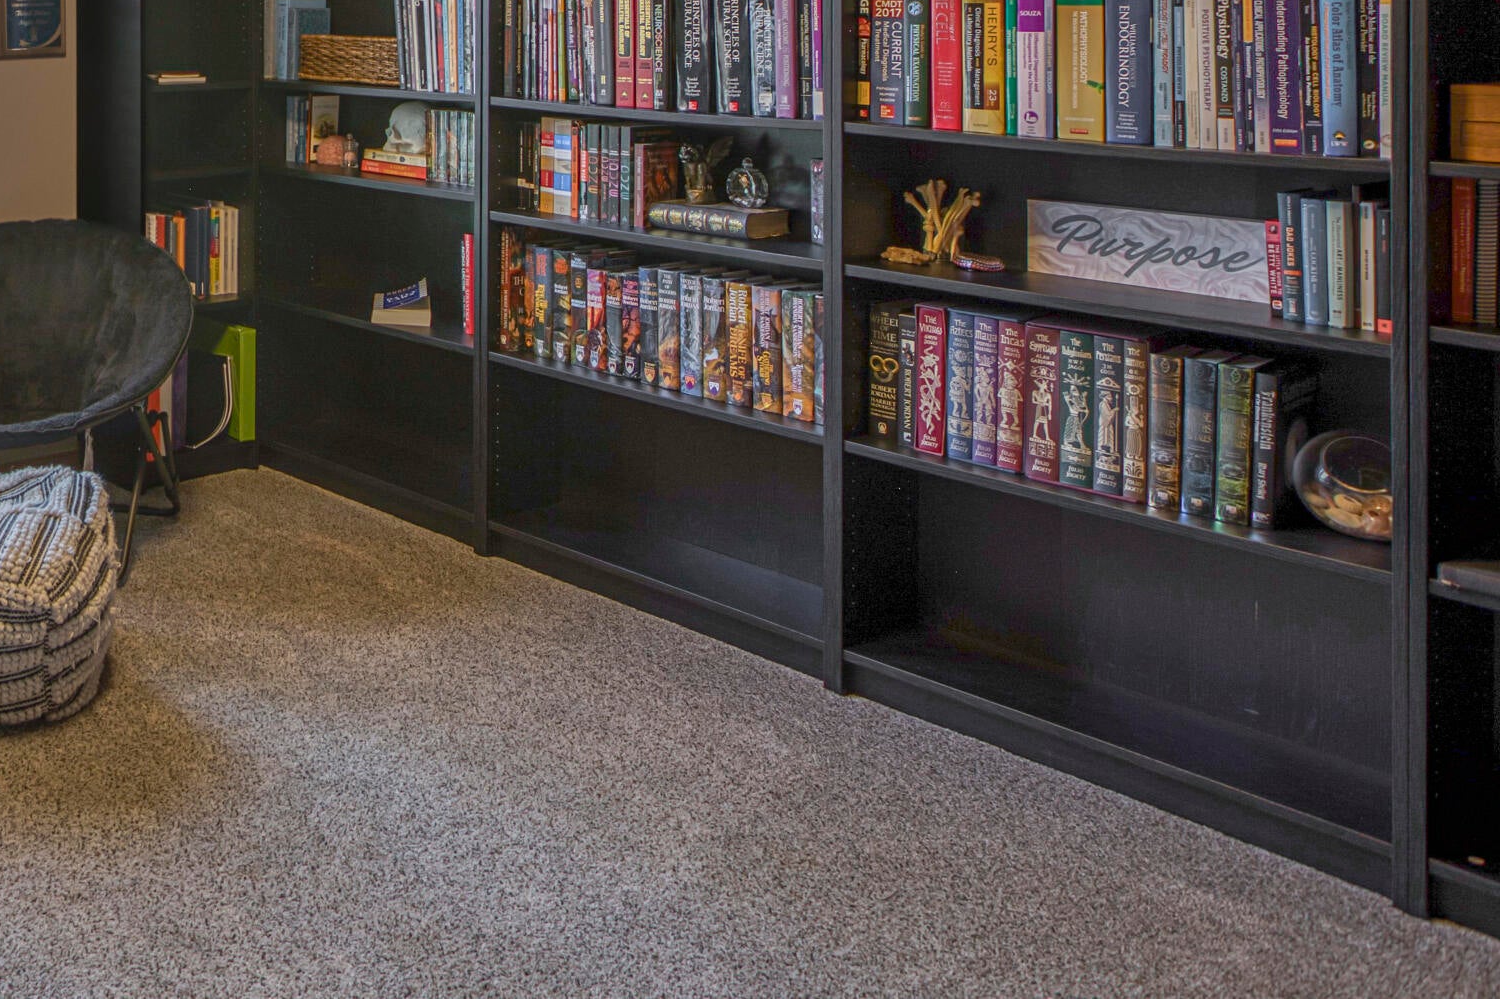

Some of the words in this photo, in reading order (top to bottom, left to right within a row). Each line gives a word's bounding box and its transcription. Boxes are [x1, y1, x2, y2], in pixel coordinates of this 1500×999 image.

[875, 0, 902, 8] CMDT
[876, 8, 901, 18] 2017
[974, 8, 982, 28] Clinical
[1332, 2, 1343, 26] Color
[756, 3, 764, 40] NEURAL
[764, 9, 772, 58] PRINCIPLES
[882, 21, 890, 48] Medical
[936, 14, 948, 45] CELL
[988, 7, 998, 66] HENRY'S
[1202, 9, 1210, 44] POSITIVE
[1255, 21, 1264, 52] APPLICATIONS
[1368, 16, 1376, 40] Medicine
[684, 30, 692, 68] SCIENCE
[724, 28, 732, 68] SCIENCE
[892, 22, 902, 78] CURRENT
[912, 24, 920, 54] PHYSICAL
[974, 30, 982, 56] Diagnosis
[1080, 11, 1088, 84] PATHOPHYSIOLOGY
[1332, 28, 1344, 52] Atlas
[692, 50, 700, 62] OF
[731, 49, 740, 62] OF
[756, 42, 764, 78] SCIENCE
[764, 60, 772, 72] OF
[882, 49, 890, 82] Diagnosis
[1118, 5, 1130, 108] ENDOCRINOLOGY
[1333, 54, 1344, 64] of
[912, 56, 920, 102] EXAMINATION
[974, 68, 982, 106] Management
[1220, 67, 1228, 102] COSTANZO
[1276, 55, 1290, 119] Pathophysiology
[1332, 66, 1344, 107] Anatomy
[1052, 214, 1265, 278] Purpose
[1286, 226, 1294, 241] DAD
[1286, 244, 1295, 266] JOKES
[728, 288, 738, 322] Jordan
[738, 290, 748, 324] Robert
[870, 316, 898, 328] WHEEL
[872, 330, 898, 342] TIME
[976, 330, 998, 342] Maya
[730, 328, 738, 378] DREAMS
[738, 329, 747, 365] KNIFE
[1001, 334, 1025, 348] Incas
[738, 367, 746, 379] OF
[904, 368, 912, 395] ROBERT
[871, 384, 896, 394] ROBERT
[871, 392, 896, 400] JORDAN
[904, 396, 912, 430] JORDAN
[1260, 390, 1276, 450] Frankenstein
